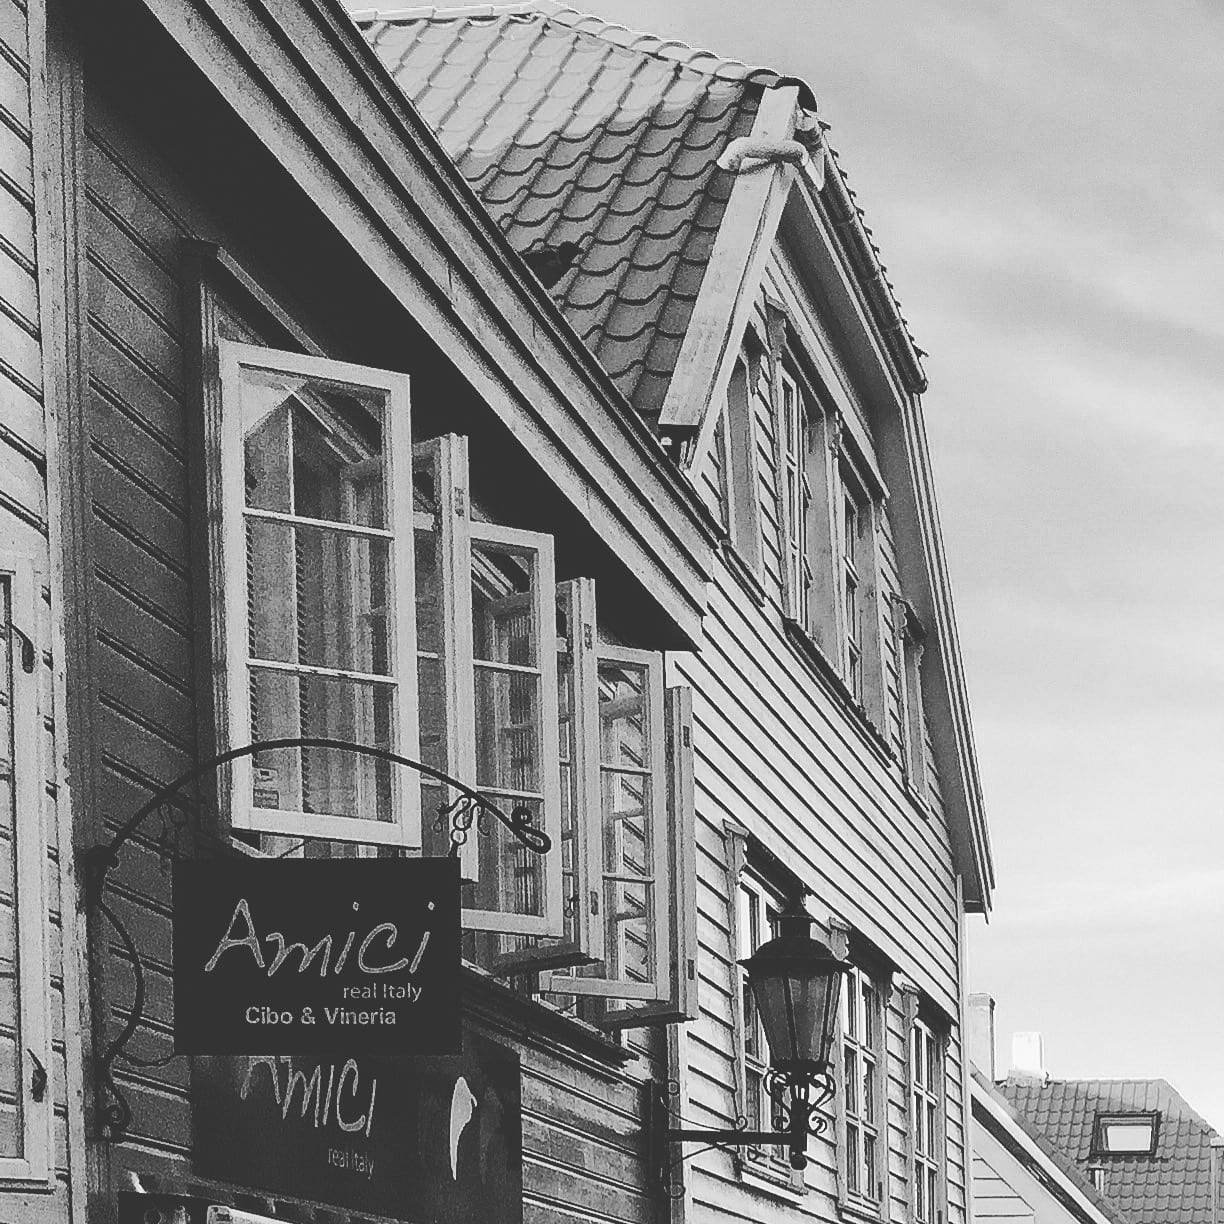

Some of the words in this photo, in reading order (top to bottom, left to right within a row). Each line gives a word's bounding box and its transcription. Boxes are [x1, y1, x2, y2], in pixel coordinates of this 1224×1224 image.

[343, 982, 378, 999] real
[383, 982, 423, 1003] Italy
[245, 1006, 294, 1025] Cibo
[301, 1006, 317, 1025] &
[323, 1006, 397, 1025] Vineria
